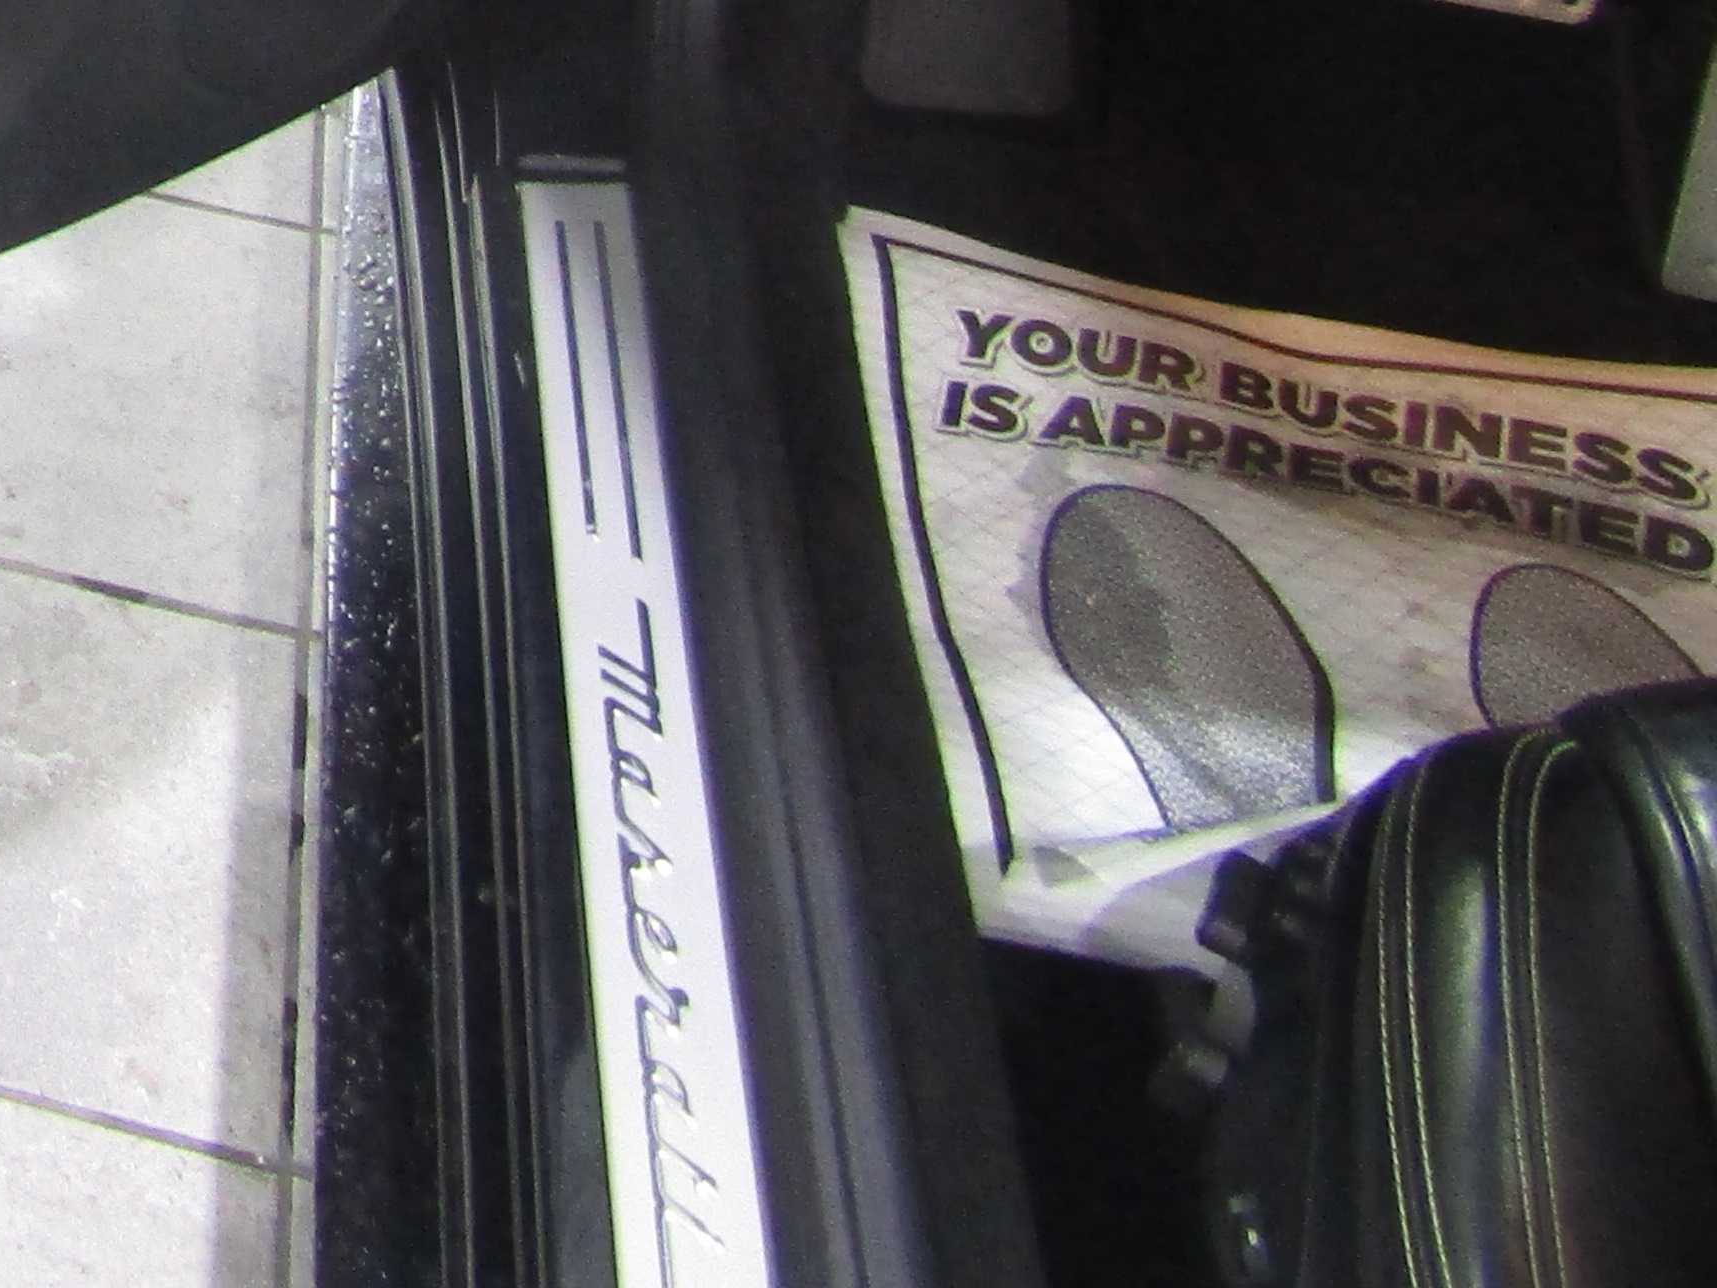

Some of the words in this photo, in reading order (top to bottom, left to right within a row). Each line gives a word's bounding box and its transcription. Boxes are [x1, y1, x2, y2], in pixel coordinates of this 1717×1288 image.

[938, 380, 1024, 435] IS
[1040, 395, 1715, 573] APPRECIATED
[957, 309, 1202, 394] YOUR
[1219, 360, 1705, 504] BUSINESS
